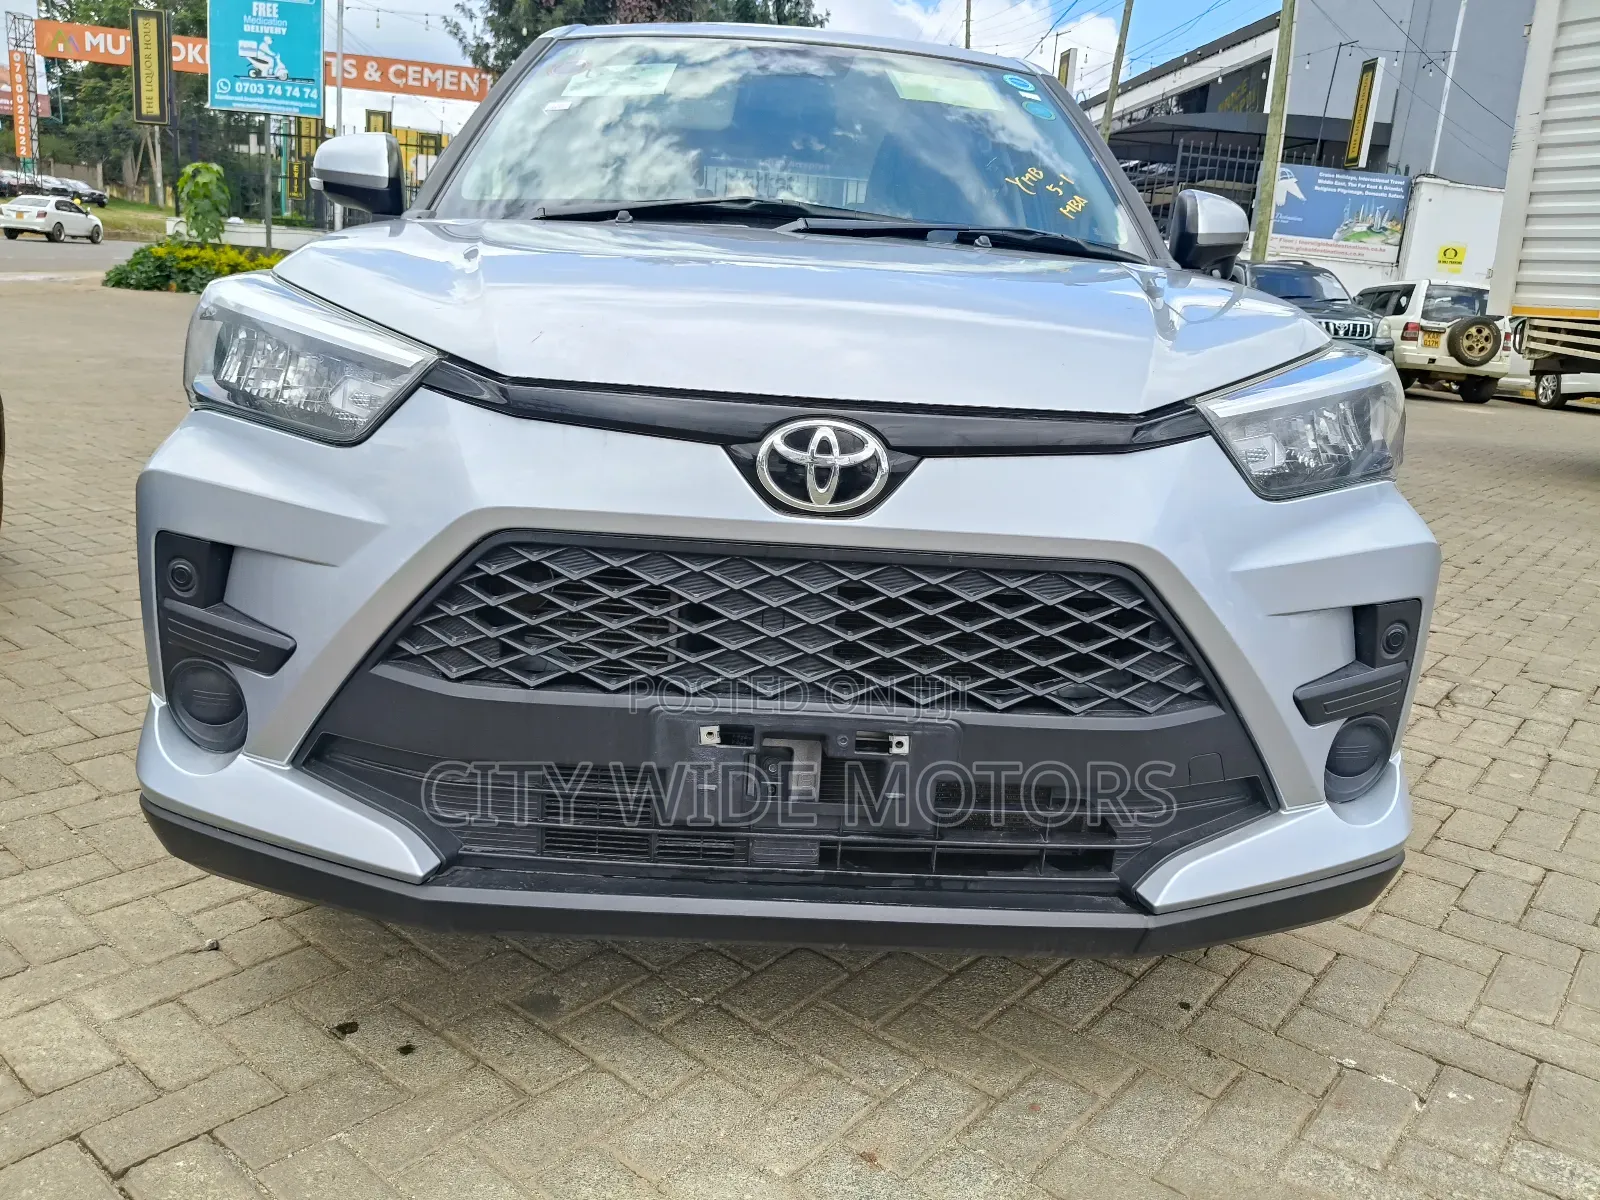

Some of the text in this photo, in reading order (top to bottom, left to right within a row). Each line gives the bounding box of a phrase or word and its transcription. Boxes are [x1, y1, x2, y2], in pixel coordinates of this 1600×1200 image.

[252, 1, 279, 18] FREE
[243, 14, 288, 27] Medication
[243, 24, 288, 36] DELIVERY
[144, 53, 155, 93] LIQUOR
[364, 60, 382, 82] &
[388, 64, 493, 96] CEMENT
[235, 82, 265, 95] 0703
[267, 85, 283, 96] 74
[285, 87, 301, 98] 74
[303, 88, 319, 100] 74
[146, 96, 154, 115] THE
